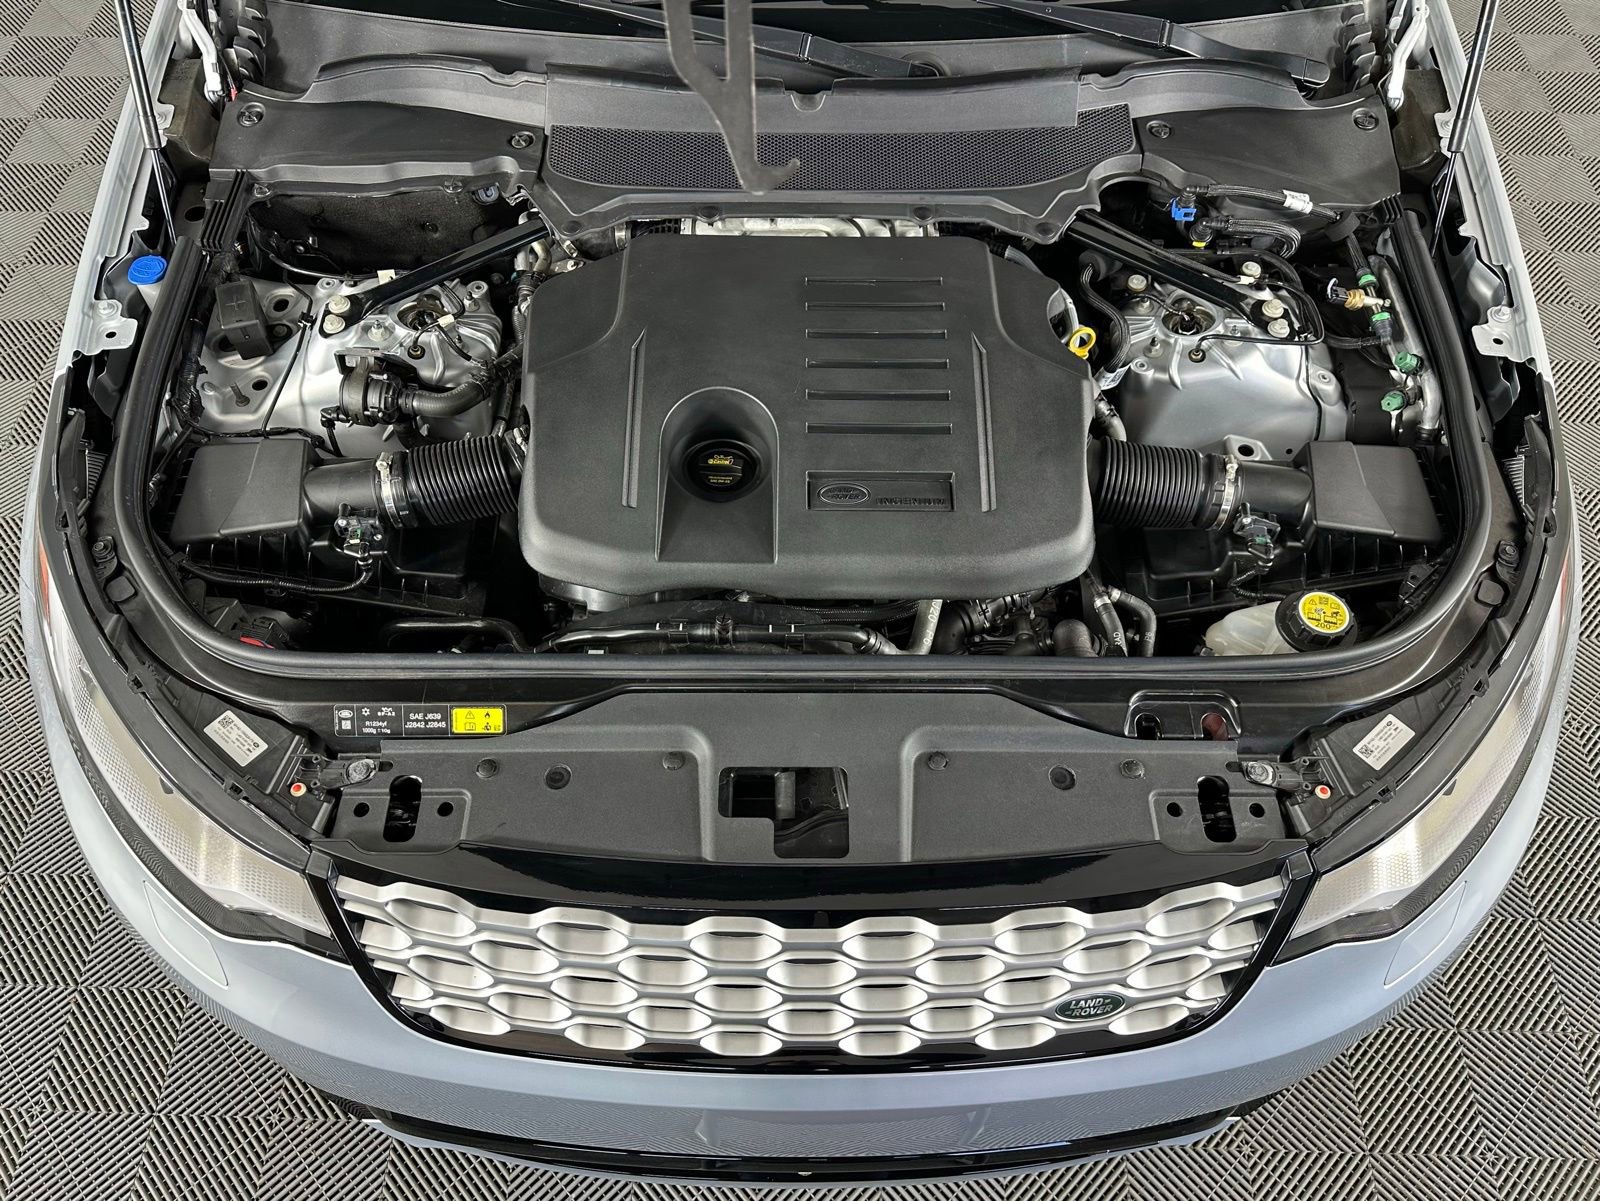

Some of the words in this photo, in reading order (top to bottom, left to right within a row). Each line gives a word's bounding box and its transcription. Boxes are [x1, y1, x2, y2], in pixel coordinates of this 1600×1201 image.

[1315, 621, 1331, 630] 200
[365, 720, 388, 728] R1234yf
[404, 721, 425, 729] J2842
[425, 721, 447, 729] J2845
[1069, 998, 1104, 1009] LAND
[1071, 1004, 1113, 1017] ROVER
